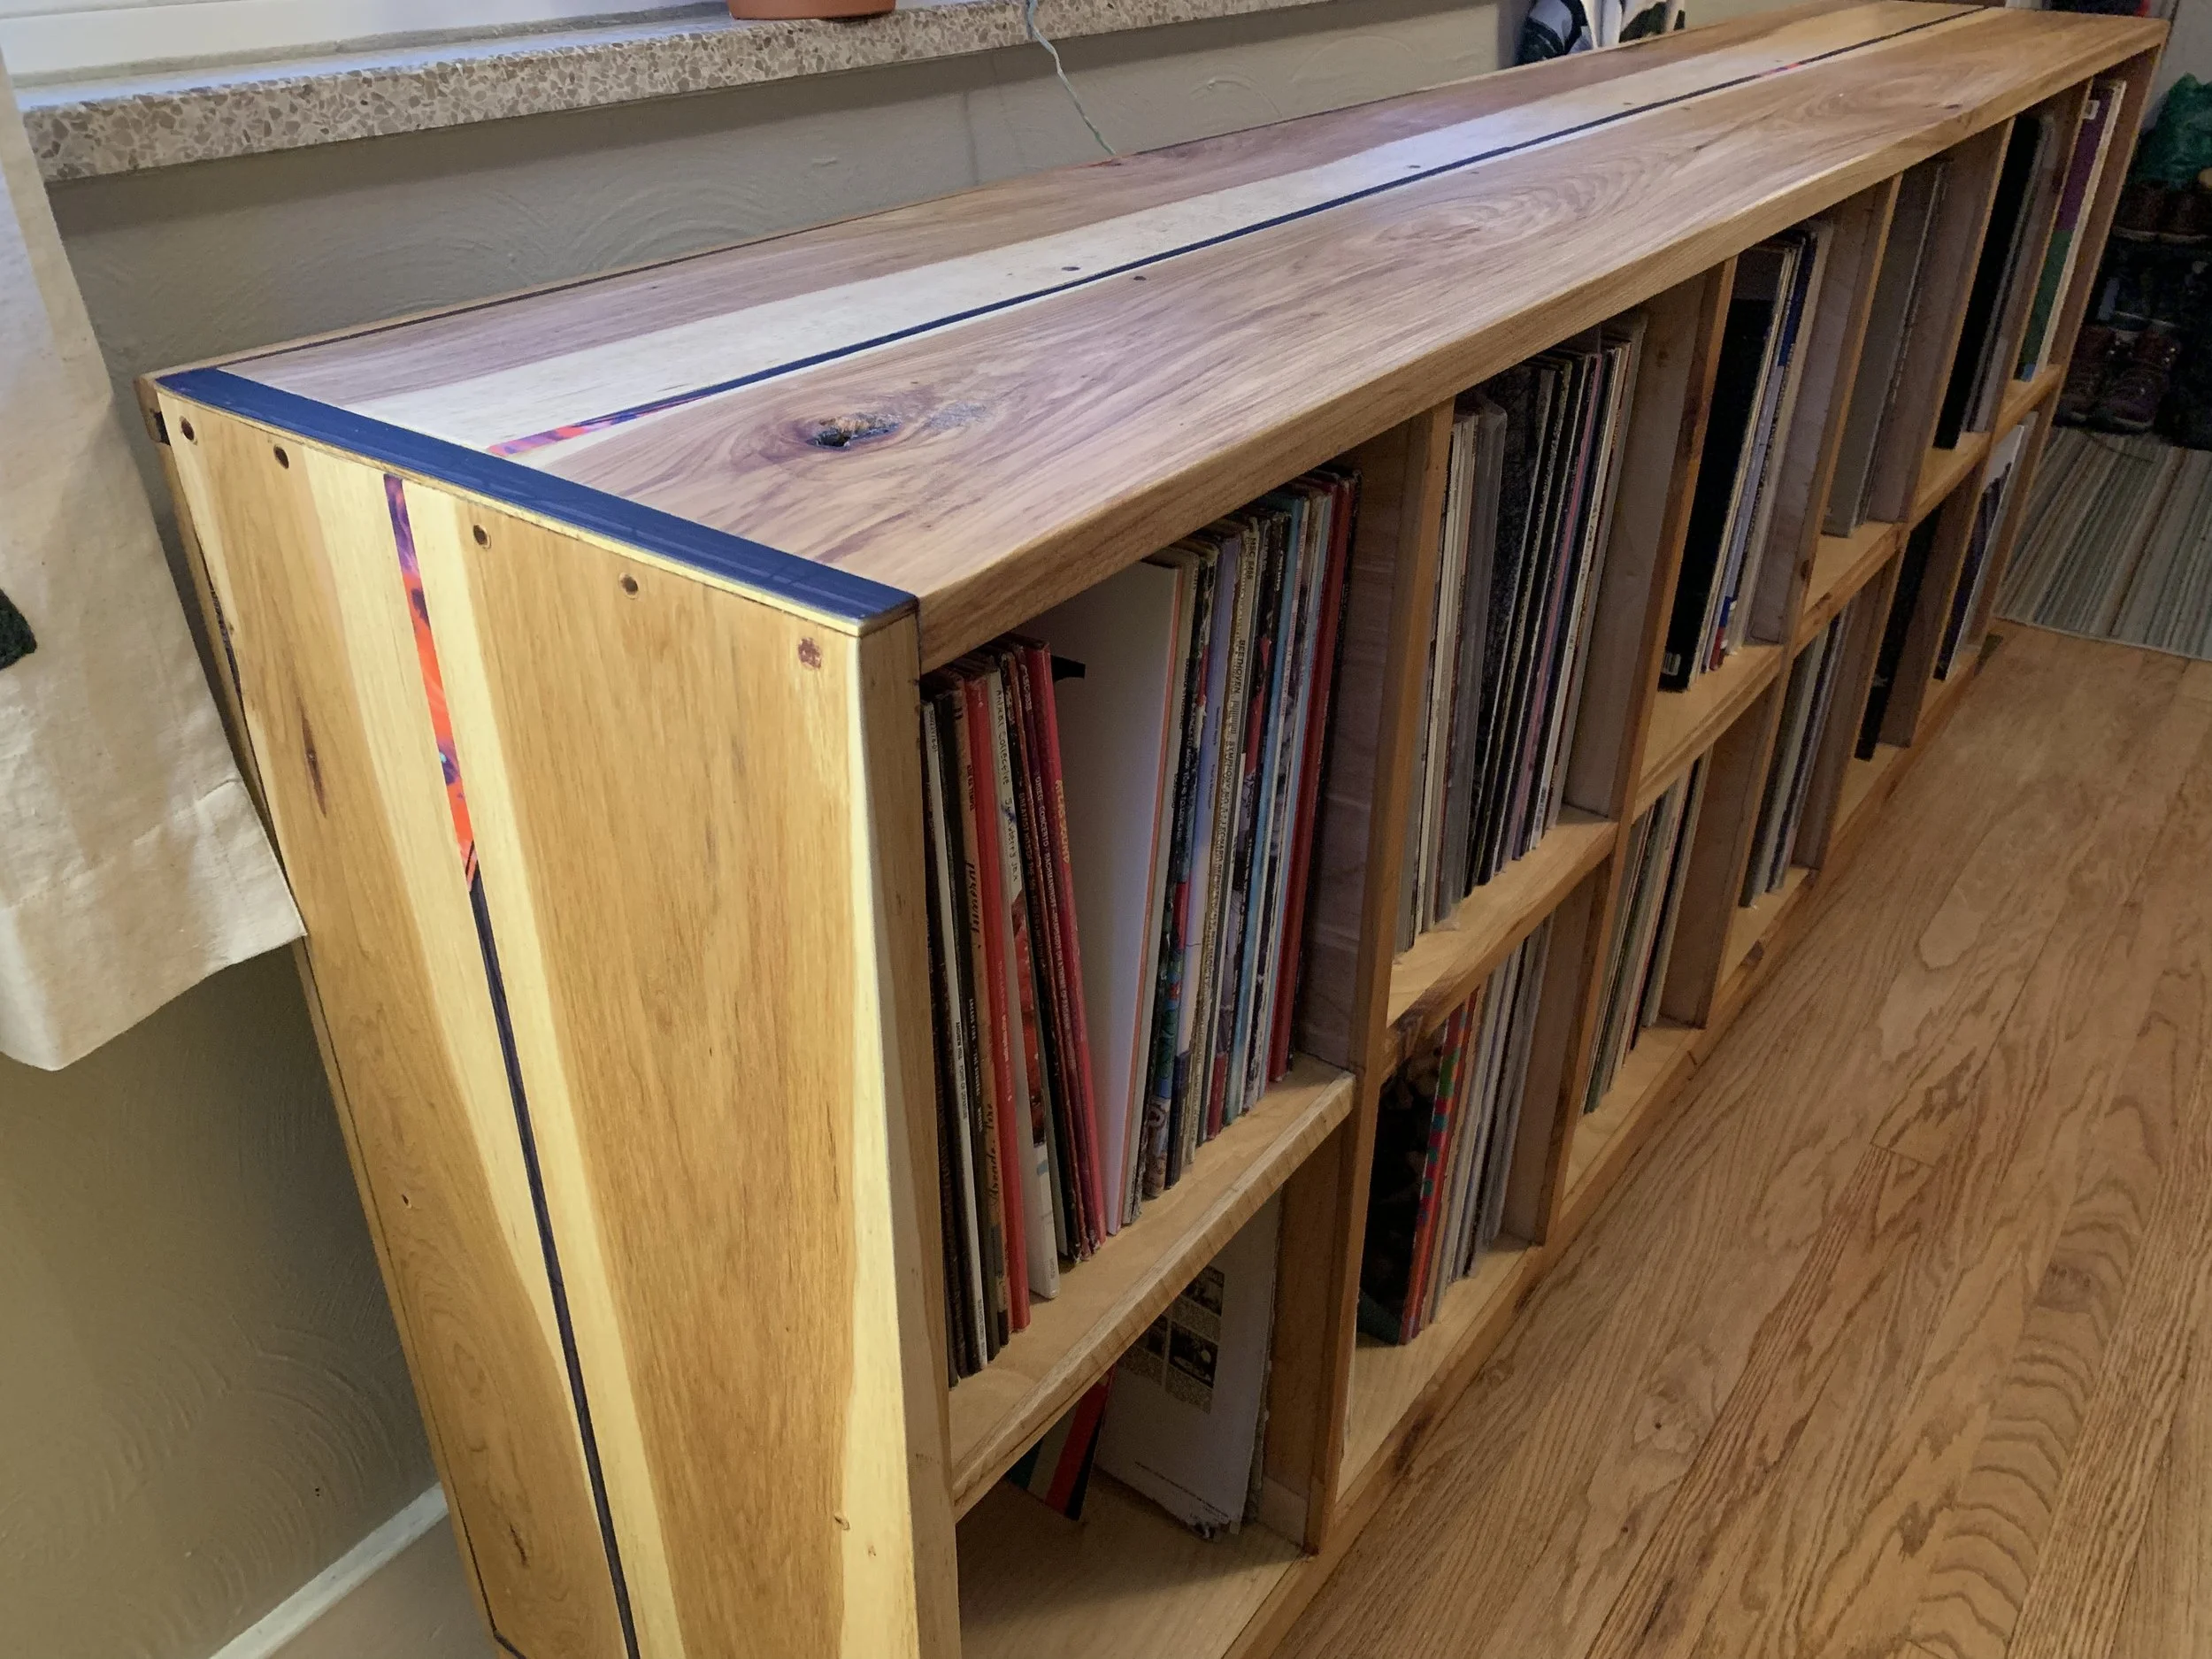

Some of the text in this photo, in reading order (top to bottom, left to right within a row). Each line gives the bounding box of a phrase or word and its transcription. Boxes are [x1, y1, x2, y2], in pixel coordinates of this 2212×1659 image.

[1234, 639, 1245, 694] BEETHOVEN
[998, 732, 1010, 785] Collective
[1225, 741, 1234, 788] SYMPHONY
[1019, 793, 1029, 831] GREATEST
[1025, 862, 1034, 877] THE
[1039, 805, 1048, 847] CONCERTO
[1059, 820, 1070, 864] SOUND
